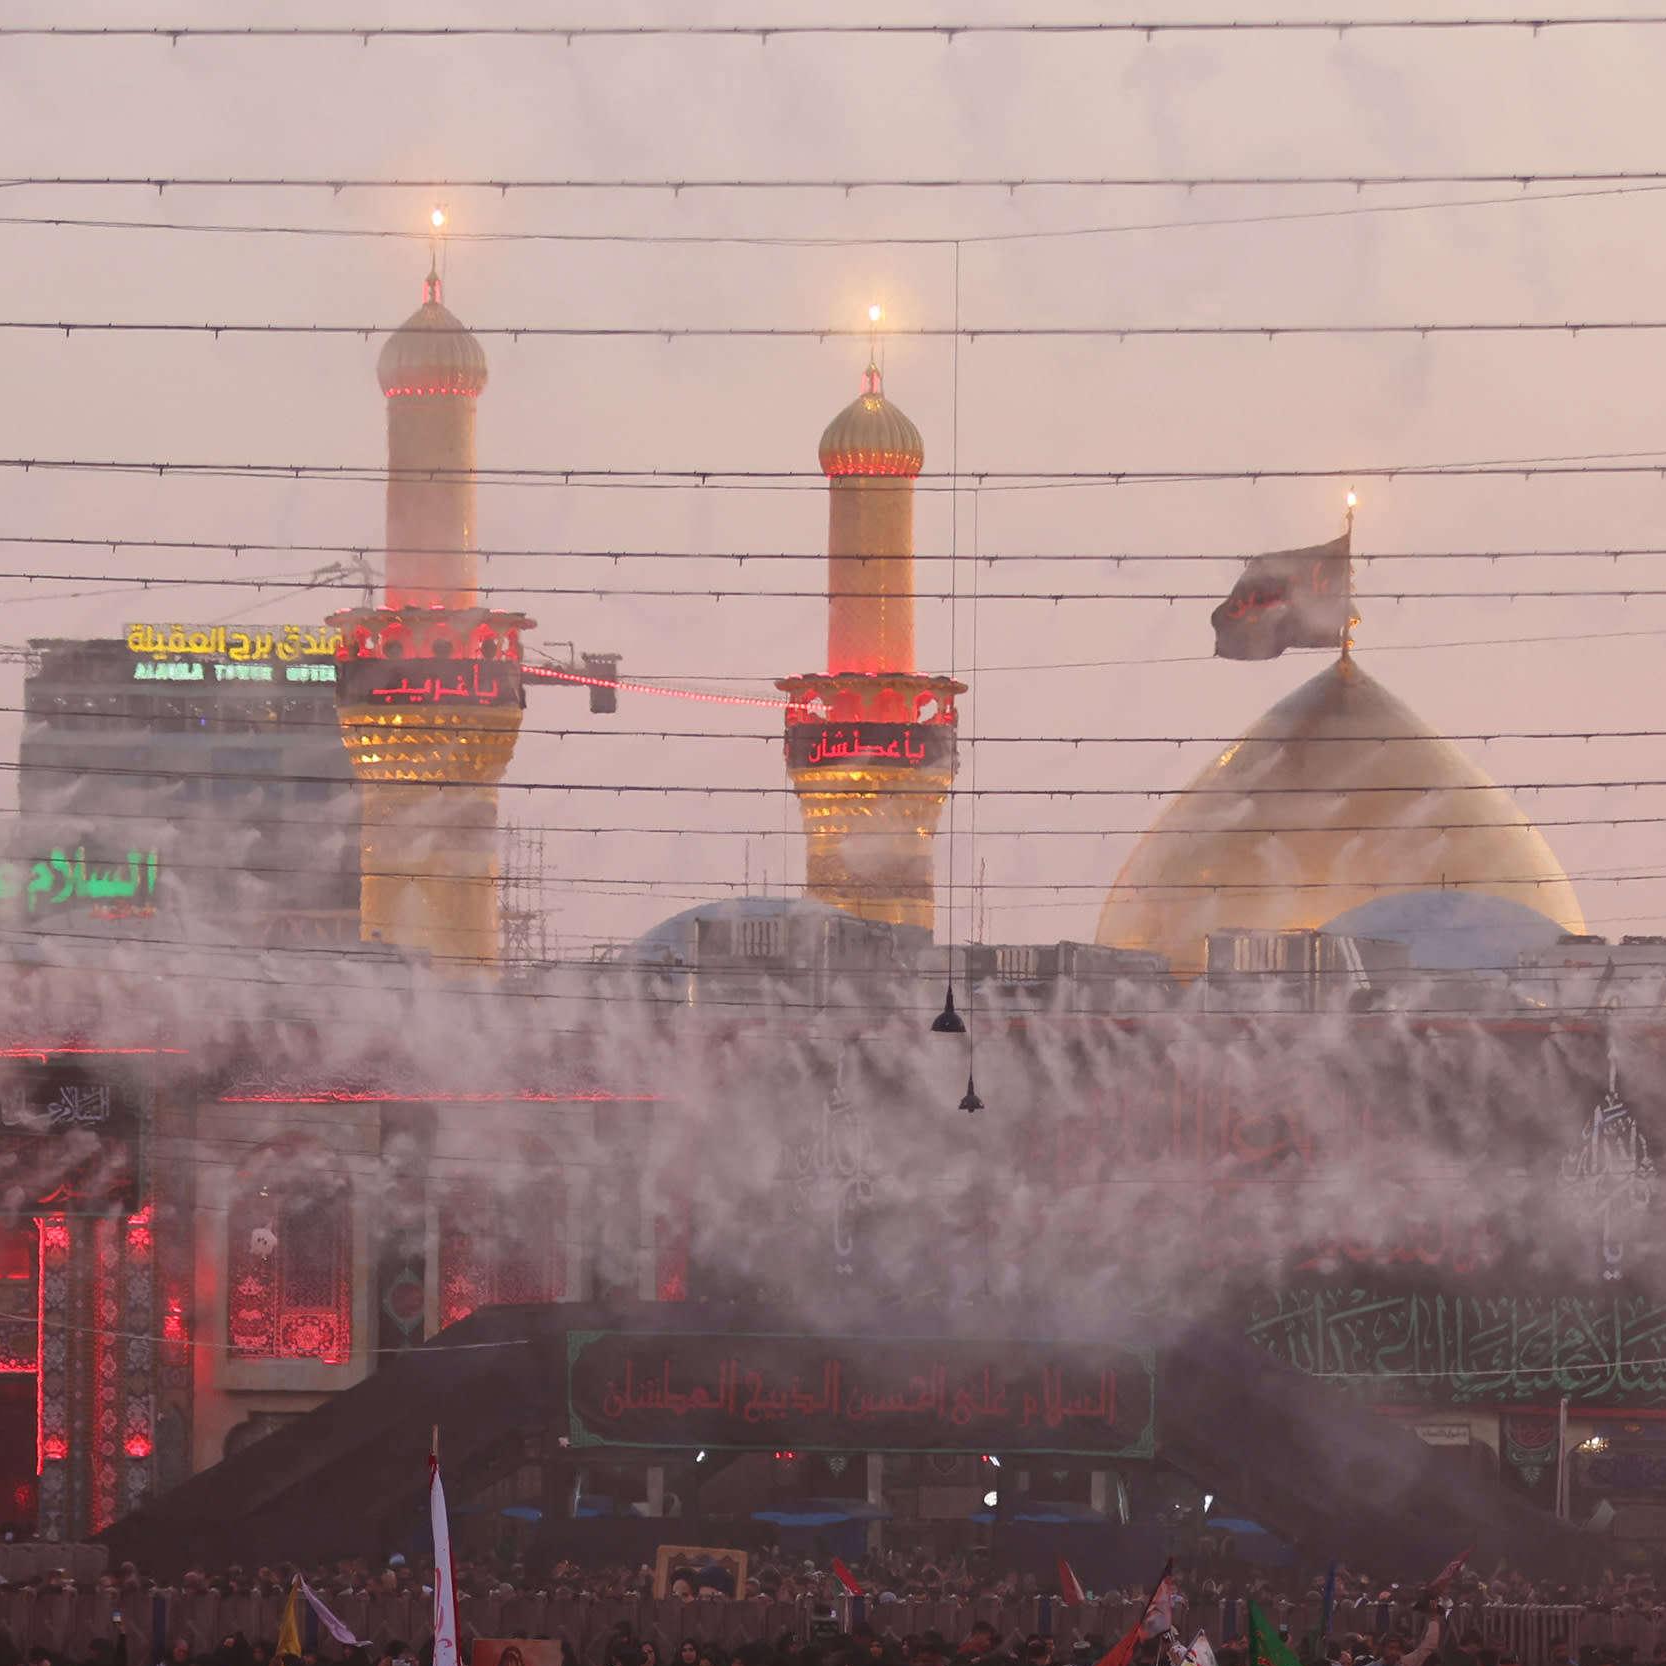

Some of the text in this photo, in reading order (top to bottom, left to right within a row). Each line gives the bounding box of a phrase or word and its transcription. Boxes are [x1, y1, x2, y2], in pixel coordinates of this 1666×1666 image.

[128, 624, 227, 660] العقيلة
[807, 728, 902, 764] عطشان
[27, 845, 158, 913] السلام
[601, 1359, 739, 1418] العطشان
[742, 1359, 842, 1423] الذبيح
[846, 1361, 948, 1422] الحسين
[1018, 1366, 1118, 1428] السلام
